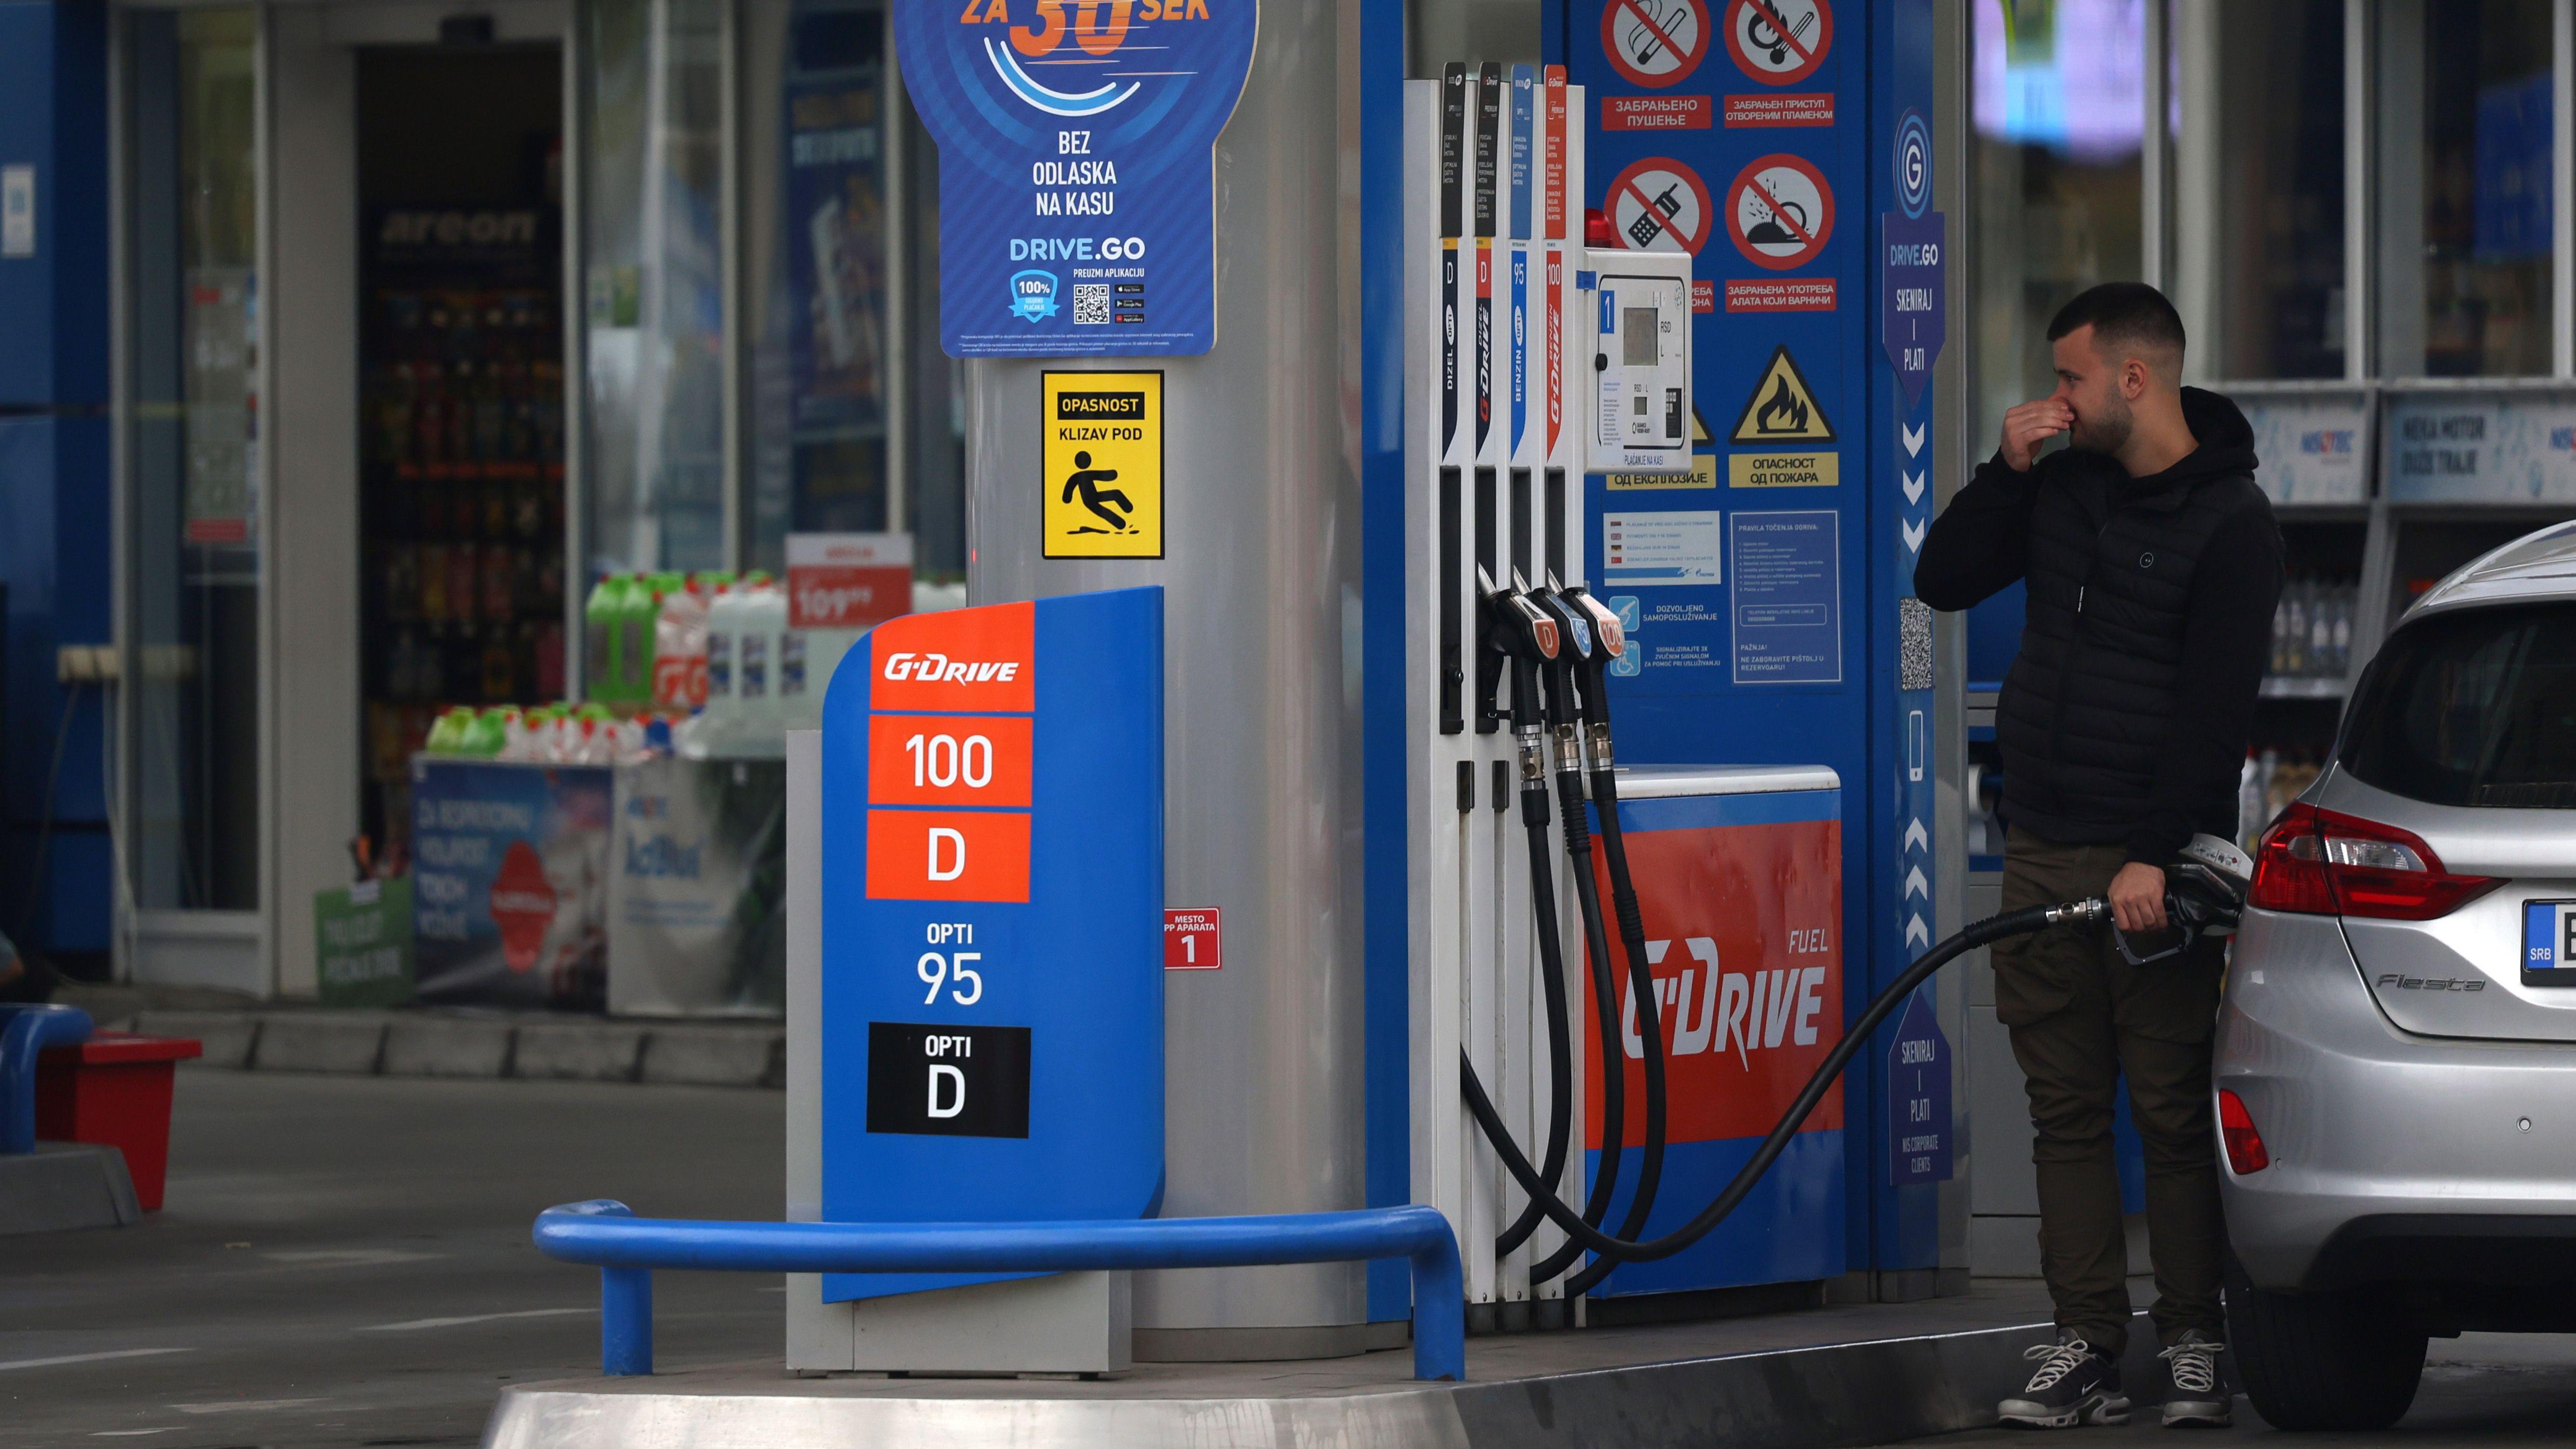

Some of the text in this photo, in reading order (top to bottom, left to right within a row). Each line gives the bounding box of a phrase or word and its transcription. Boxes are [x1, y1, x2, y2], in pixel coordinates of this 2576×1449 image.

[961, 0, 1008, 24] ZA
[1138, 0, 1209, 21] SEK
[1616, 100, 1698, 112] ЗАБРАЊЕНО
[1726, 110, 1833, 121] ОТВОРЕНИМ ПЛАМЕНОМ
[1733, 100, 1825, 109] ЗАБРАЊЕН ПРИСТУП
[1627, 115, 1686, 127] ПУШЕЊЕ
[1058, 130, 1091, 155] BEZ
[1033, 161, 1117, 186] ODLASKA
[1906, 144, 1922, 190] G
[1036, 191, 1114, 216] NA KASU
[380, 210, 535, 243] areon
[1010, 237, 1146, 261] DRIVE.GO
[1891, 243, 1938, 267] DRIVE.GO
[1073, 268, 1145, 278] PREUZMI APLIKACIJU
[1447, 261, 1453, 284] D
[1480, 261, 1487, 283] D
[1514, 263, 1524, 285] 95
[1547, 263, 1560, 285] 100
[1019, 281, 1051, 294] 100%
[1728, 285, 1834, 295] ЗАБРАЊЕНА УПОТРЕБА
[1731, 296, 1830, 306] АЛАТА КОЈИ ВАРНИЧИ
[1896, 288, 1933, 311] SKENIRAJ
[1605, 295, 1610, 329] 1
[1661, 321, 1672, 334] RSD
[1550, 308, 1560, 424] G-DRIVE
[1904, 348, 1925, 371] PLATI
[1062, 398, 1139, 412] OPASNOST
[1059, 428, 1142, 441] KLIZAV POD
[1624, 453, 1664, 465] PLAĆANJE NA KASI
[1752, 458, 1815, 469] ОПАСНОСТ
[1614, 473, 1708, 487] ОД ЕКСПЛОЗИЈЕ
[1750, 472, 1819, 485] ОД ПОЖАРА
[1643, 611, 1717, 622] SAMOPOSLUŽIVANJE
[1544, 626, 1553, 649] D
[1603, 622, 1623, 646] 100
[884, 652, 1019, 687] G-DRIVE
[905, 733, 993, 789] 100
[928, 827, 966, 881] D
[926, 923, 973, 945] OPTI
[1177, 923, 1215, 932] APARATA
[1181, 934, 1195, 963] 1
[1788, 928, 1829, 955] FUEL
[2530, 948, 2551, 960] SRB
[917, 953, 983, 1006] 95
[2375, 973, 2486, 992] Fiesta
[925, 1035, 971, 1058] OPTI
[1902, 1039, 1935, 1064] SKENIRAJ
[928, 1065, 966, 1119] D
[1910, 1098, 1930, 1122] PLATI
[1911, 1134, 1938, 1152] CORPORATE
[1911, 1156, 1931, 1174] CLIENTS
